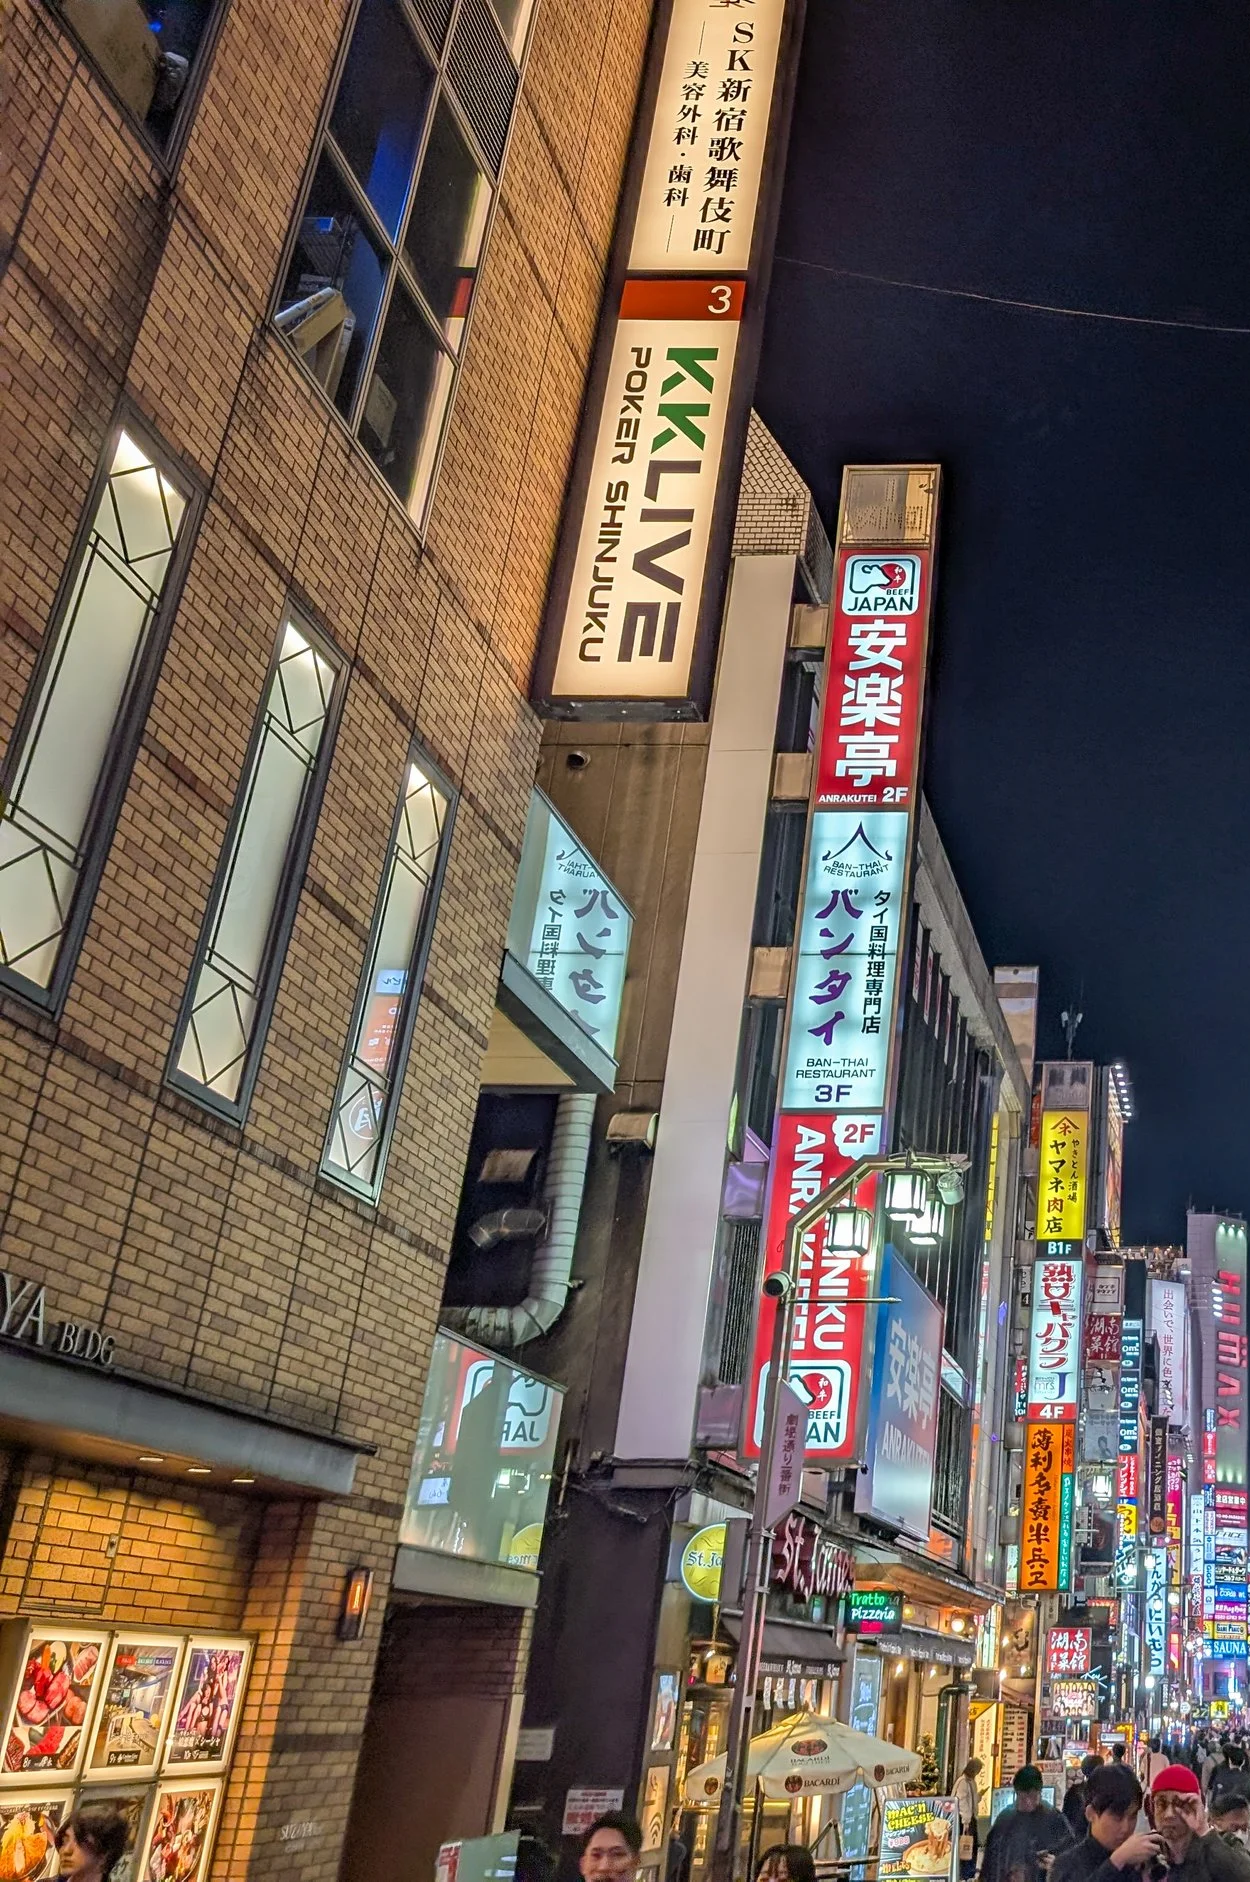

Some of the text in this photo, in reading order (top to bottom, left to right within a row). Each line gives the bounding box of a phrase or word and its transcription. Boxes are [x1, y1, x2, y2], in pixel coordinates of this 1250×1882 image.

[663, 60, 708, 208] 美容外科・歯科
[708, 285, 732, 314] 3
[578, 347, 651, 663] POKER SHINJUKU
[617, 347, 719, 663] KKLIVE
[848, 596, 914, 611] JAPAN
[835, 619, 907, 788] 安楽亭
[818, 787, 908, 803] ANRAKUTEI 2F
[823, 864, 889, 878] RESTAURANT
[832, 861, 881, 871] BAN-THAI
[808, 889, 863, 1045] バンタイ
[861, 890, 891, 1034] タイ国料理専門店
[806, 1058, 868, 1067] BAN-THAI
[796, 1070, 876, 1079] RESTAURANT
[815, 1085, 852, 1102] 3F
[843, 1124, 875, 1143] 2F
[1067, 1139, 1080, 1203] やきとん酒場
[1044, 1140, 1066, 1234] ヤマネ肉店
[1048, 1242, 1072, 1255] B1F
[58, 1322, 116, 1365] BLDG
[887, 1318, 936, 1430] 安楽亭
[817, 1378, 829, 1401] 和牛
[1040, 1404, 1064, 1418] 4F
[778, 1413, 799, 1496] 劇場通り一番街
[851, 1607, 895, 1620] Pizzeria
[1051, 1631, 1087, 1650] 湖南
[1213, 1641, 1247, 1654] SAUNA
[888, 1812, 934, 1830] CHEESE
